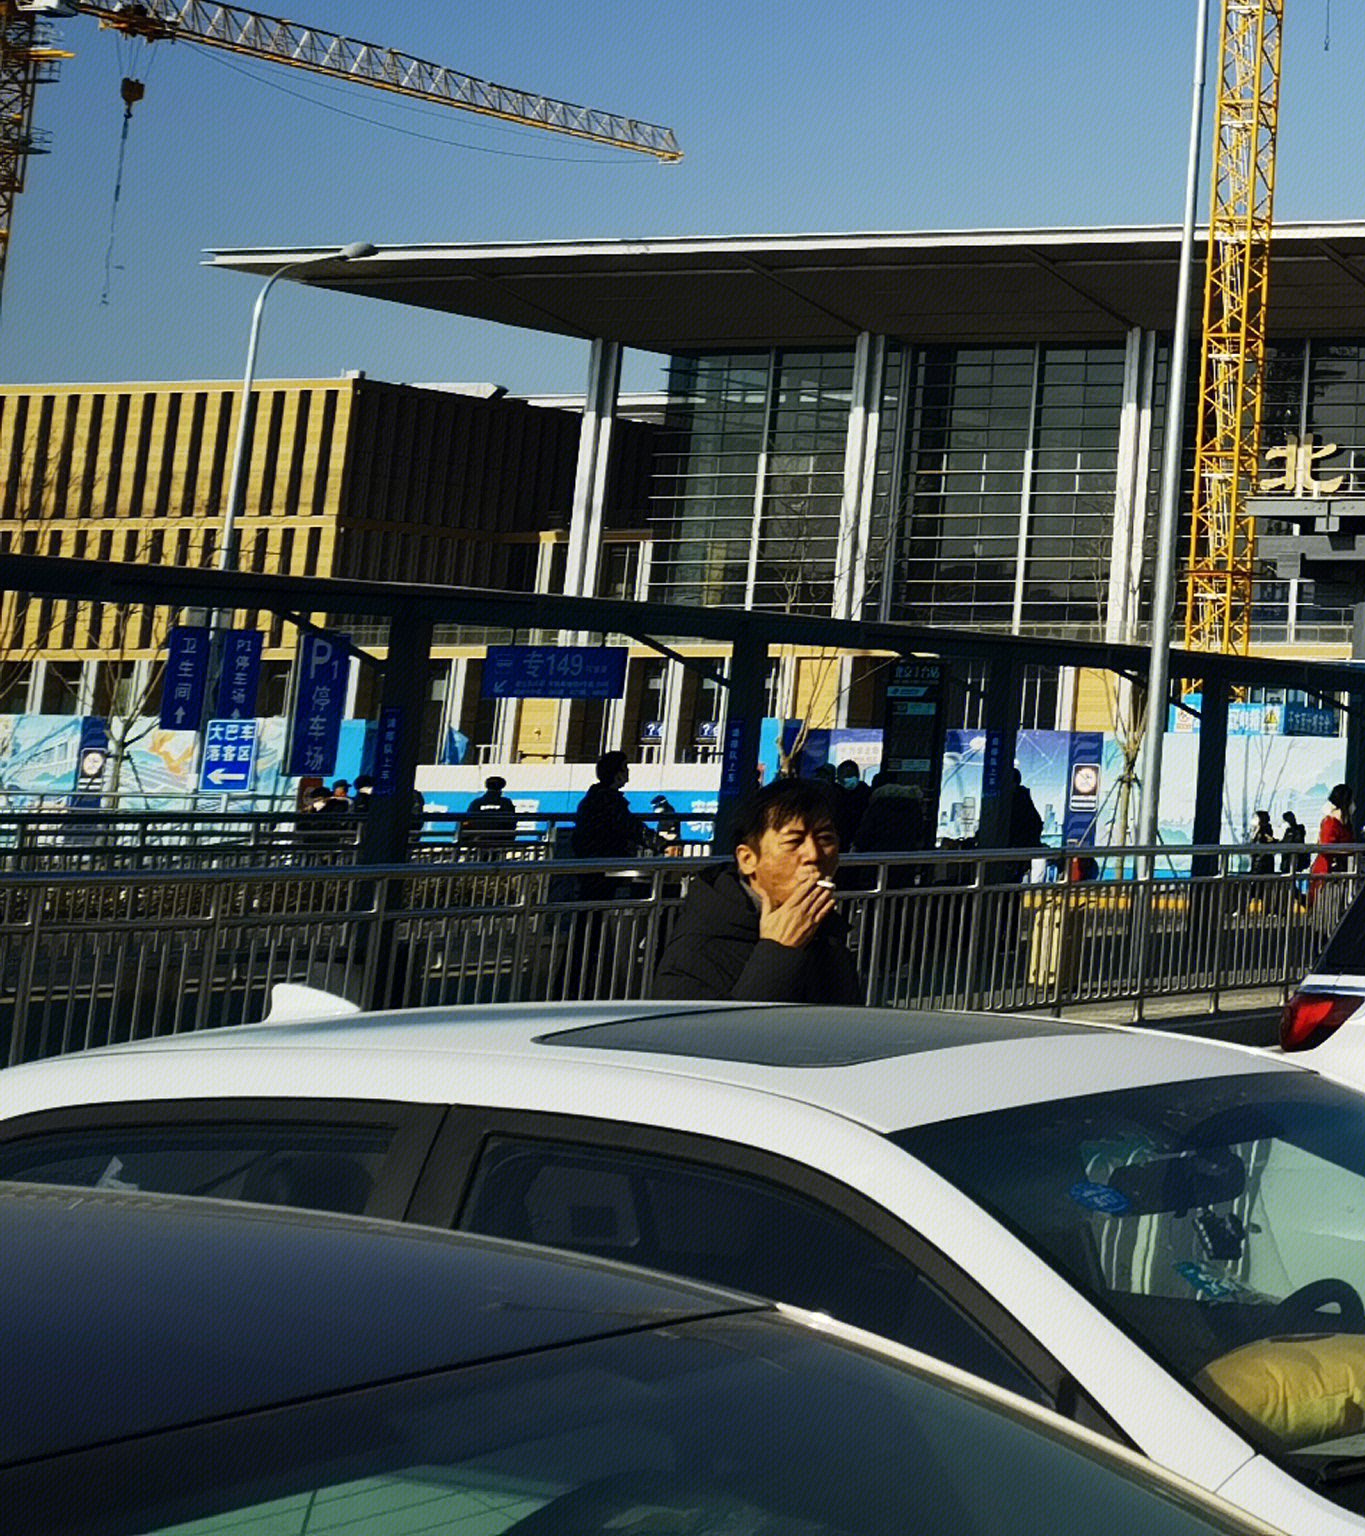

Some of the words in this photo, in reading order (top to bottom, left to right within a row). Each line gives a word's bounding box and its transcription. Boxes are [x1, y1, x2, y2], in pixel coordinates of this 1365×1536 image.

[174, 637, 198, 702] 卫生间
[522, 650, 584, 678] 专149
[208, 724, 256, 741] 大巴车
[304, 685, 331, 772] 停车场
[205, 744, 251, 762] 落客区
